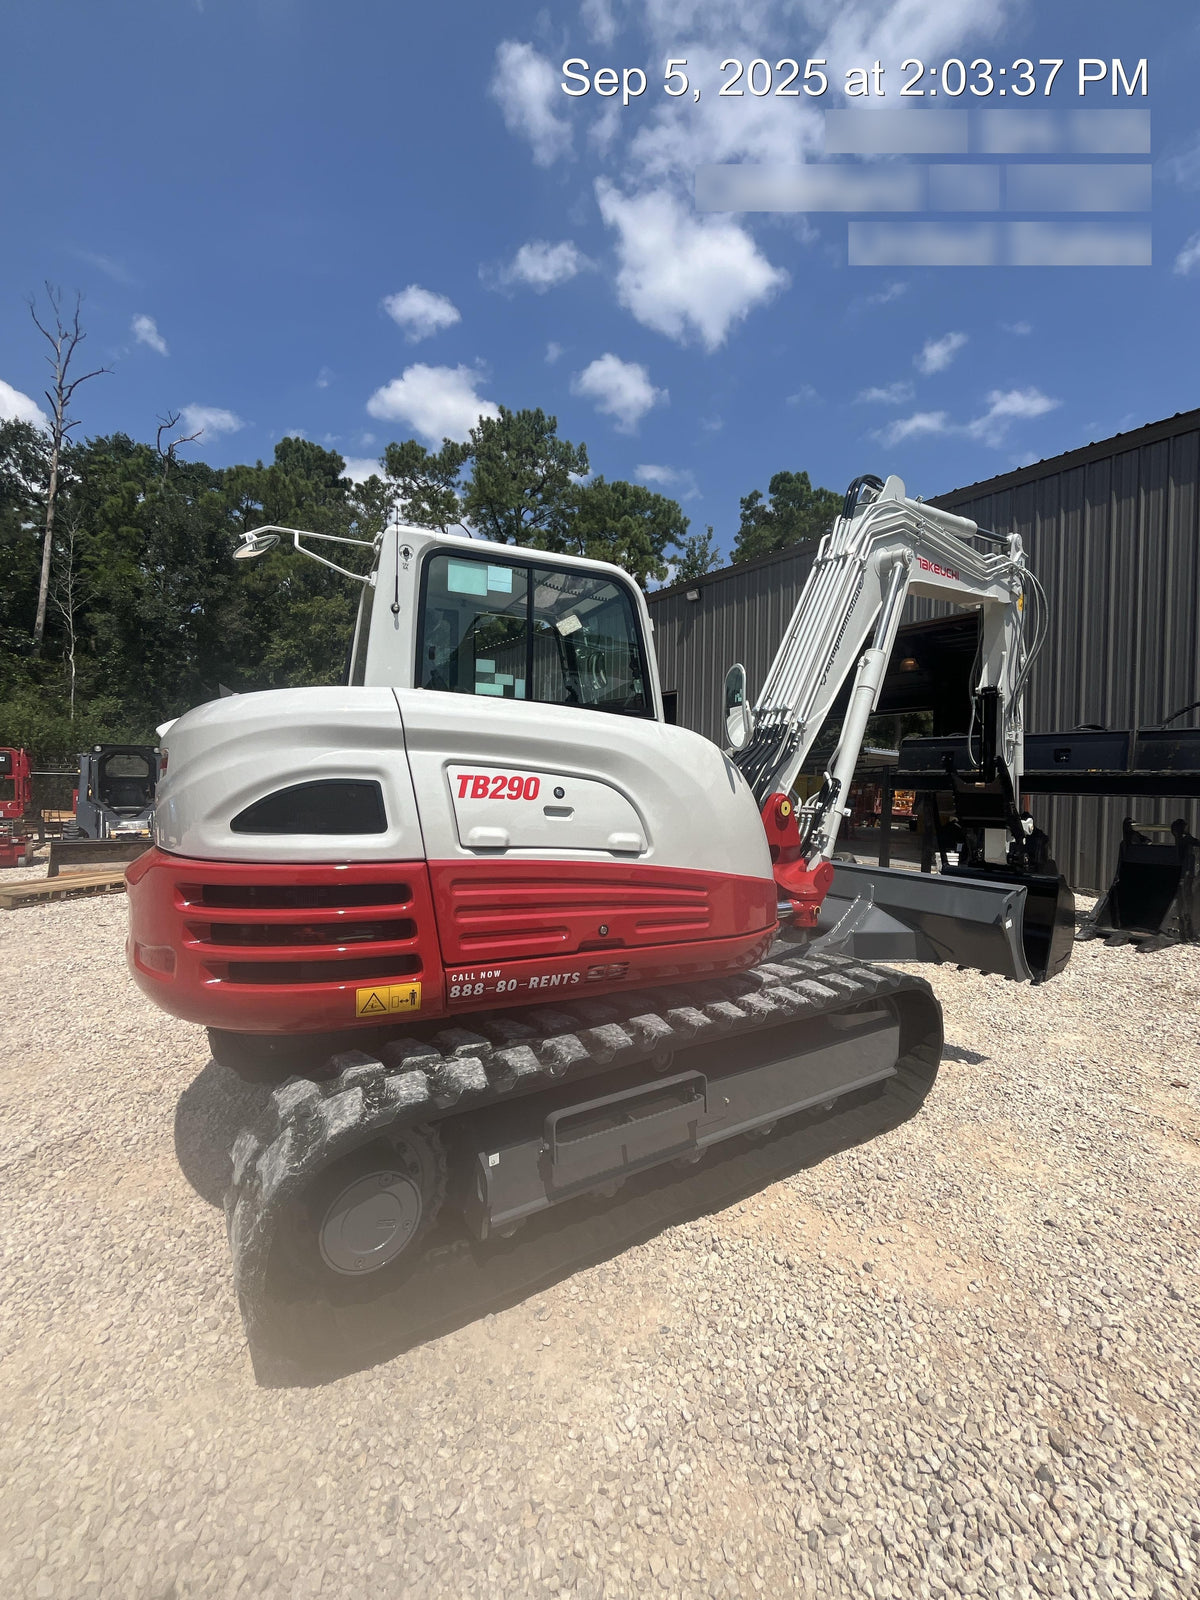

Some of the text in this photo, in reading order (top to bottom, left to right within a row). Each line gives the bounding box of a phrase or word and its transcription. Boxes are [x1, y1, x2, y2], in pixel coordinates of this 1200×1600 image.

[456, 774, 541, 801] TB290
[449, 972, 581, 998] 888-80-RENTS
[451, 970, 502, 982] CALL NOW
